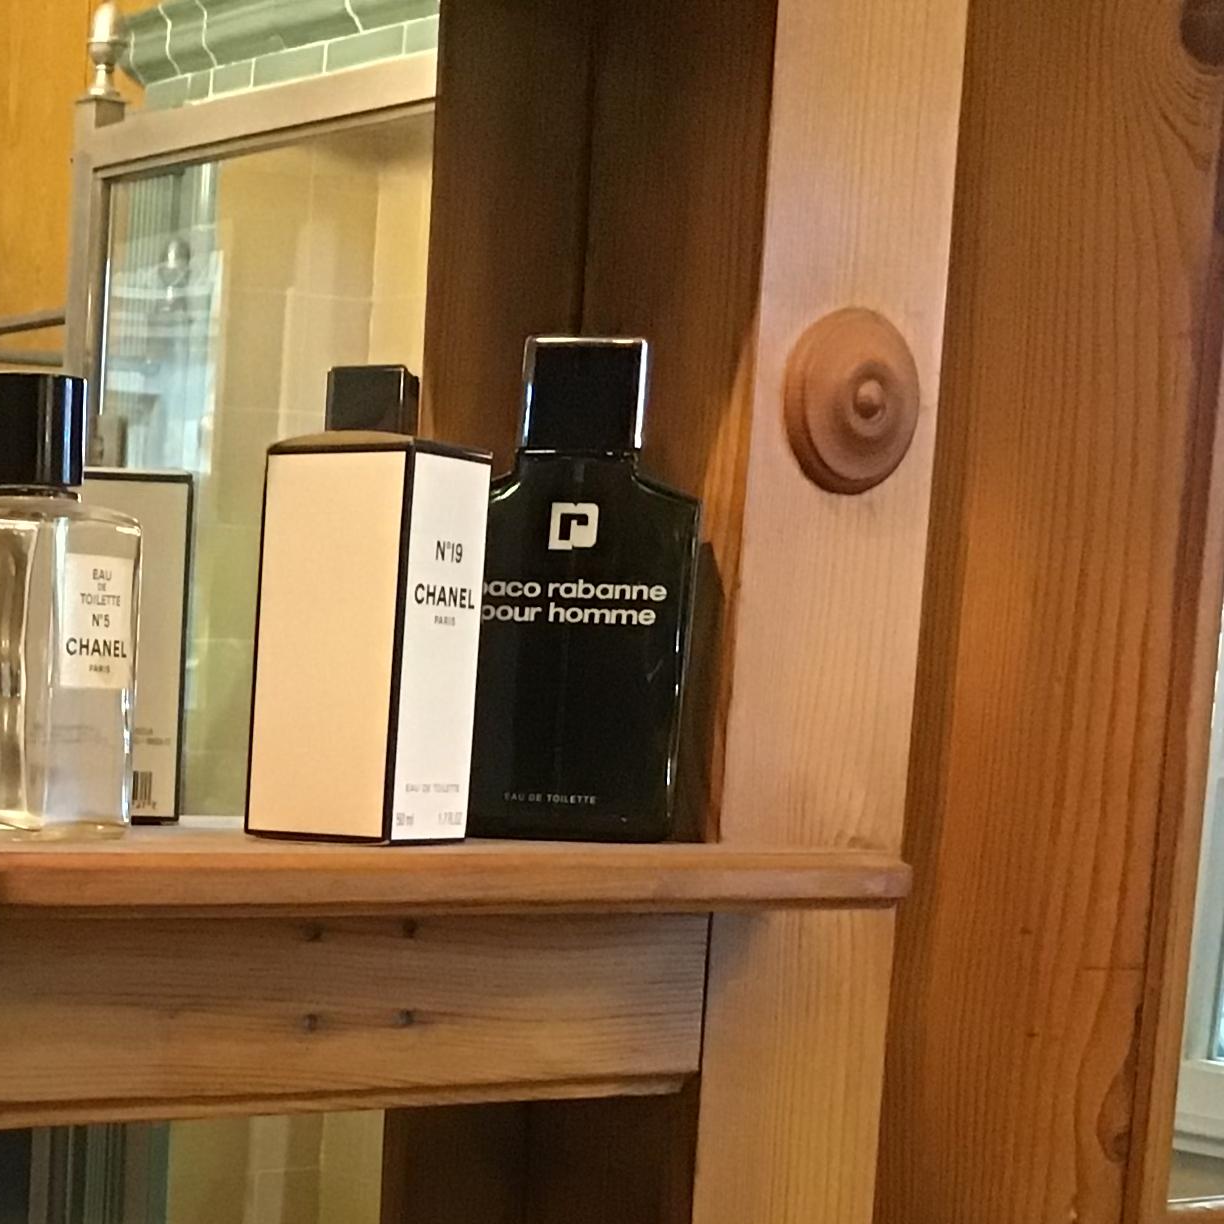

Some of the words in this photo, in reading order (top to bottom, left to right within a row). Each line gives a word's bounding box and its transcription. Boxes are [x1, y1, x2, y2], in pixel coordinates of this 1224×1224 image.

[92, 568, 112, 581] EAU
[414, 582, 475, 609] CHANEL
[548, 579, 668, 601] rabanne
[79, 593, 121, 607] TOILETTE
[548, 602, 656, 625] homme
[434, 615, 456, 627] PARIS
[65, 637, 127, 658] CHANEL
[88, 664, 111, 674] PARIS
[503, 792, 525, 801] EAU
[528, 793, 542, 802] DE
[546, 794, 596, 805] TOILETTE
